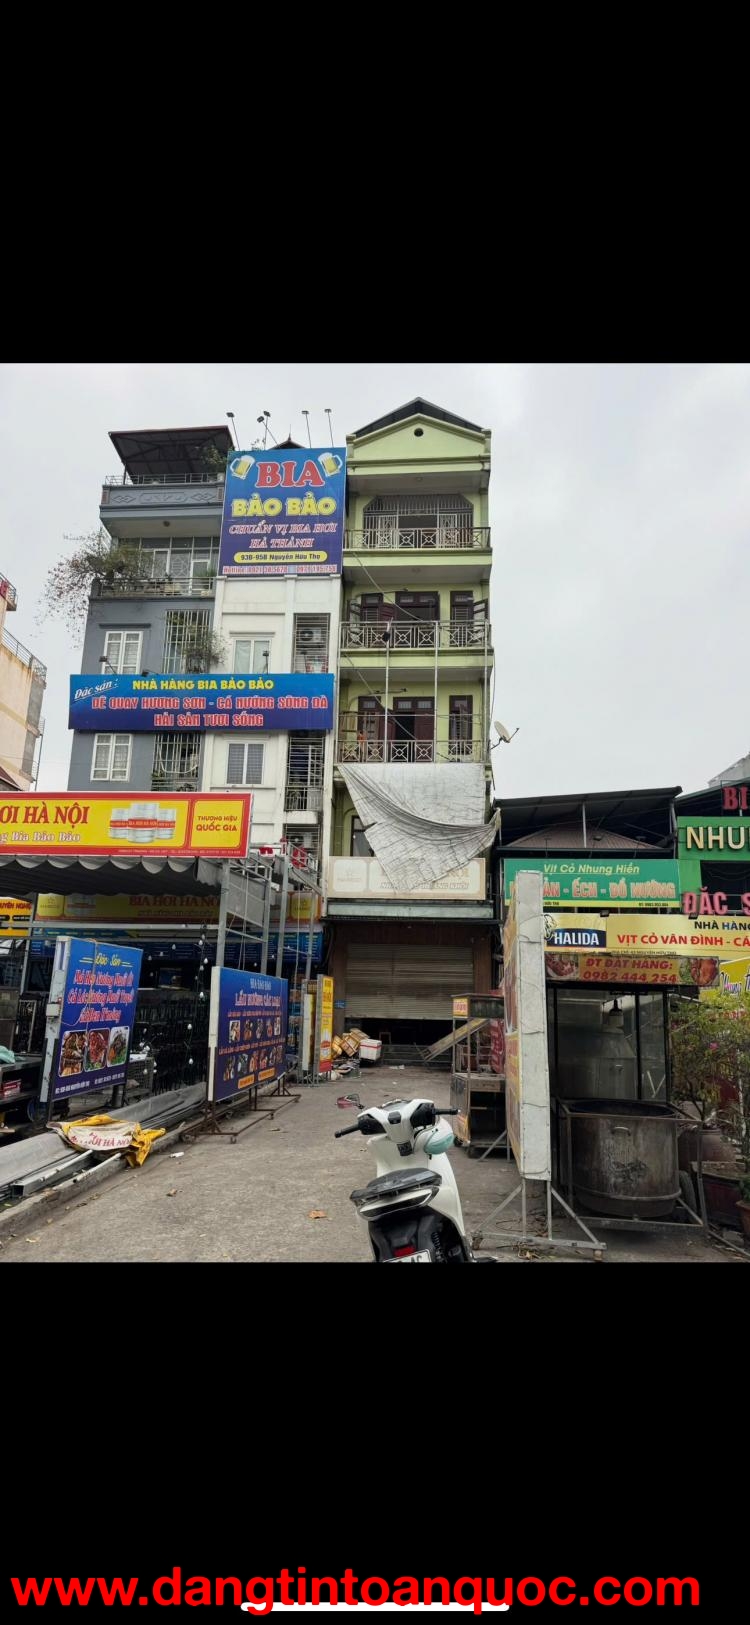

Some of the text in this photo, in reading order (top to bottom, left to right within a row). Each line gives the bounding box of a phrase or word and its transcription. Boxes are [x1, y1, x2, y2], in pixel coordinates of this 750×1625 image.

[255, 460, 325, 488] BIA
[231, 491, 337, 517] BẢO BẢO
[289, 523, 311, 534] BIA
[132, 677, 274, 690] NHÀ HÀNG BIA BẢO BẢO
[22, 801, 50, 824] HÀ
[53, 802, 91, 829] NỘI
[196, 821, 238, 832] QUỐC GIA
[686, 826, 750, 850] NHU
[578, 864, 613, 876] Nhung
[694, 920, 750, 931] NHÀ HÀN
[554, 931, 600, 946] HALIDA
[617, 934, 638, 946] VỊT
[641, 932, 658, 944] CỎ
[690, 934, 723, 946] ĐÌNH
[586, 958, 602, 967] ĐT
[583, 971, 677, 983] 0982 444 254
